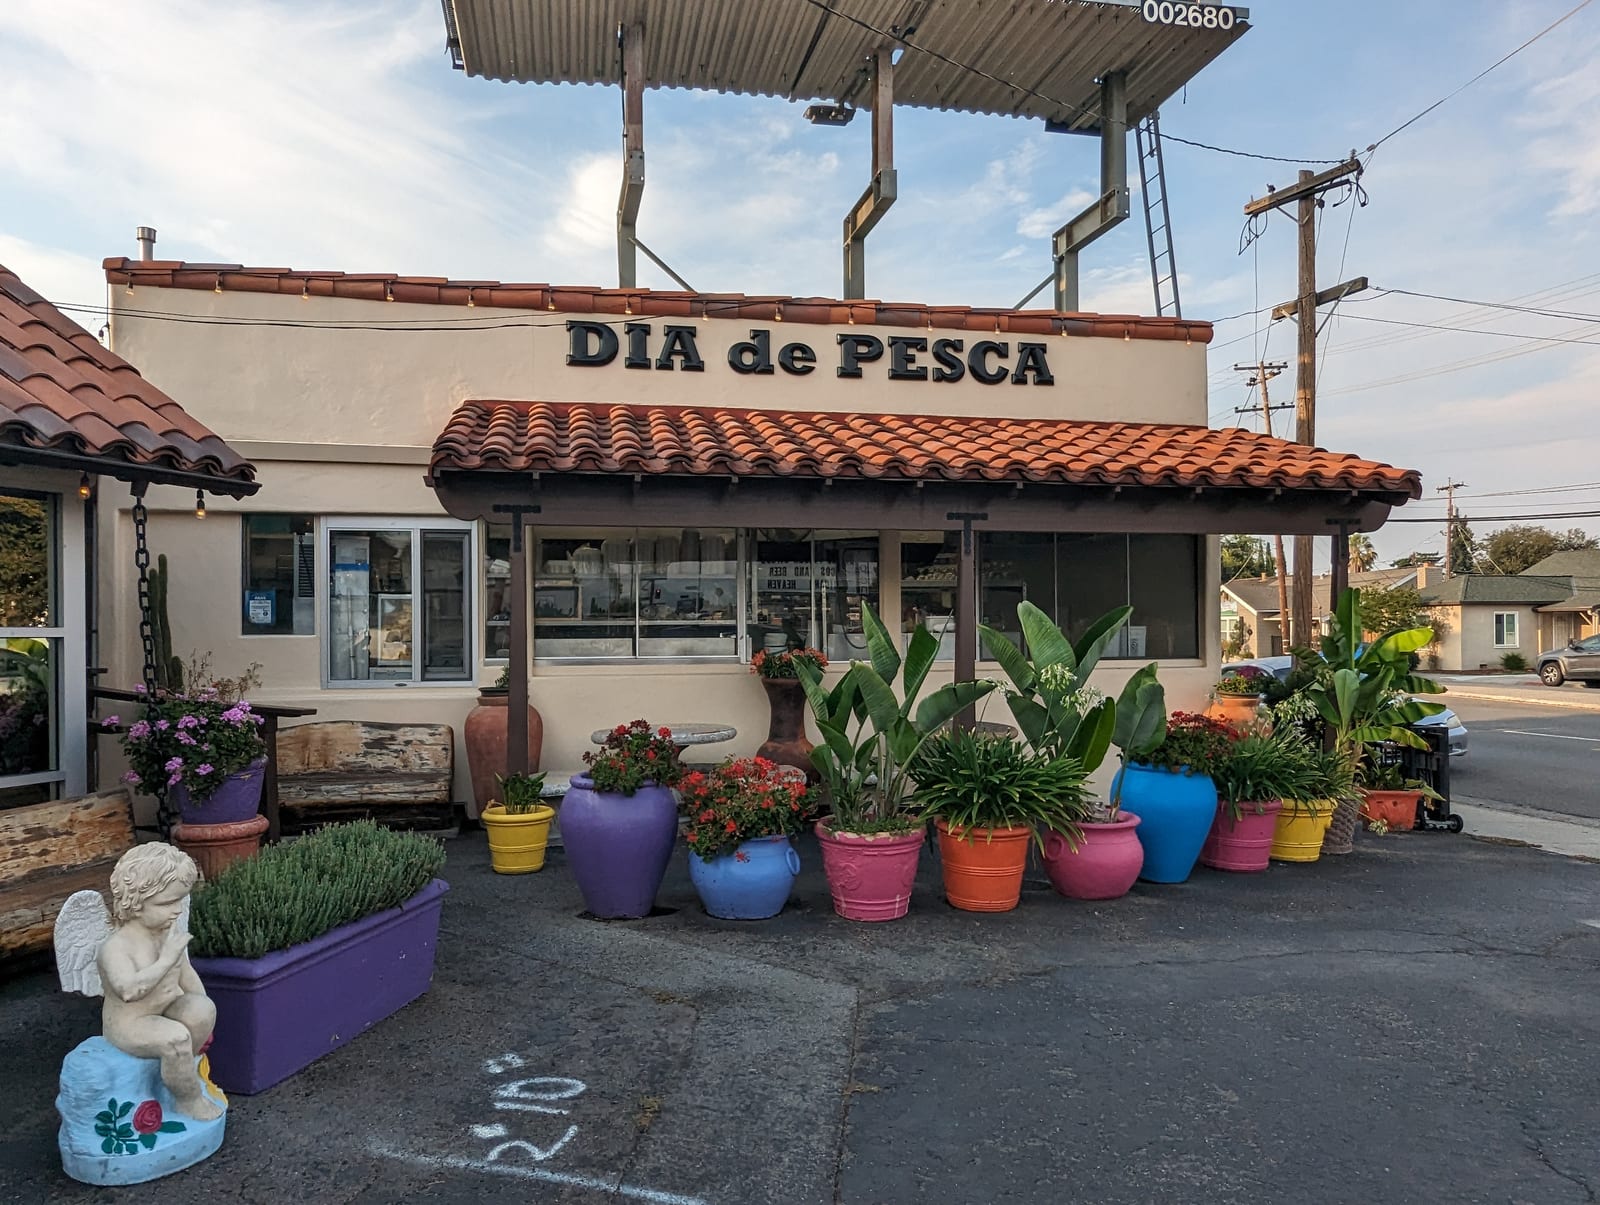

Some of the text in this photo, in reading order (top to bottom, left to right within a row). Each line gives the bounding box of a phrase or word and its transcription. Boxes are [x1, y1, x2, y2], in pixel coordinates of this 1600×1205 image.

[1143, 0, 1234, 30] 002680
[566, 319, 1055, 386] DIA de PESCA
